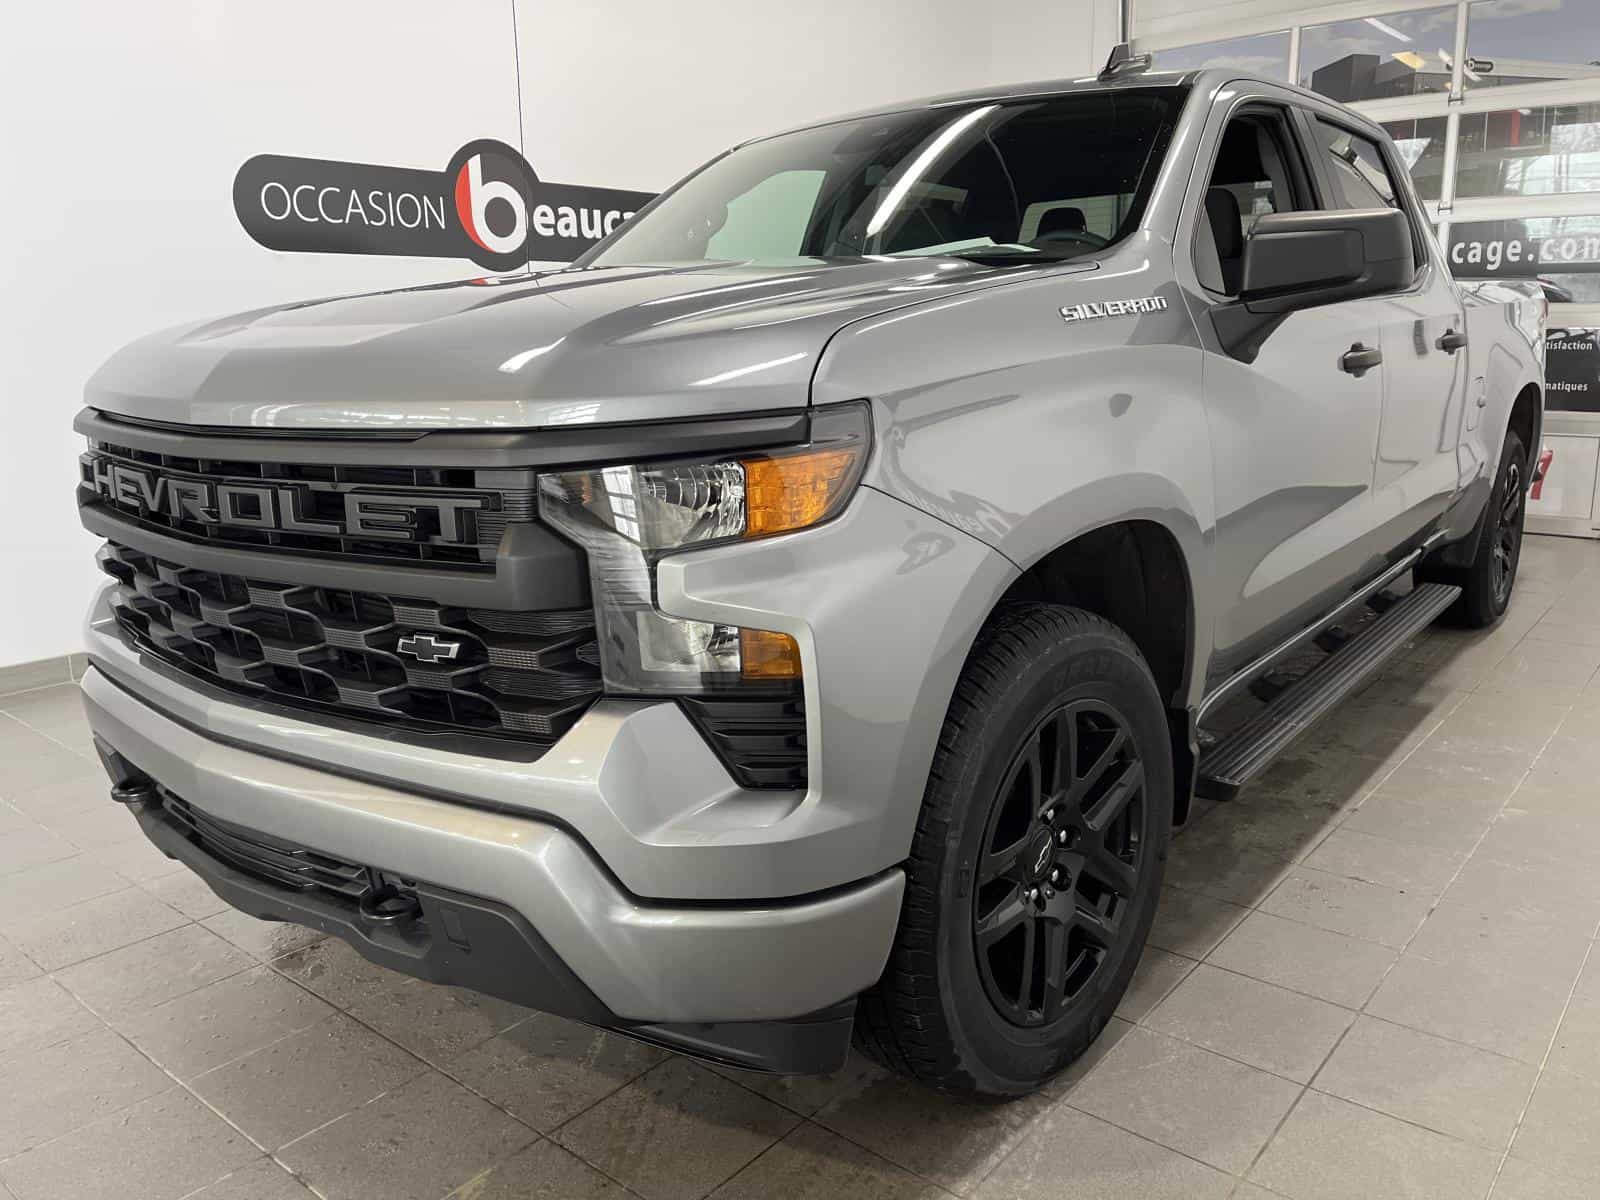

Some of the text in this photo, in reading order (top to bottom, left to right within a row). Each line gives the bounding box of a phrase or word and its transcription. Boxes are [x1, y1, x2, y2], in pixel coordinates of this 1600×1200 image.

[260, 181, 447, 230] OCCASION
[1060, 296, 1168, 322] SILVERADO
[79, 451, 486, 545] CHEVROLET
